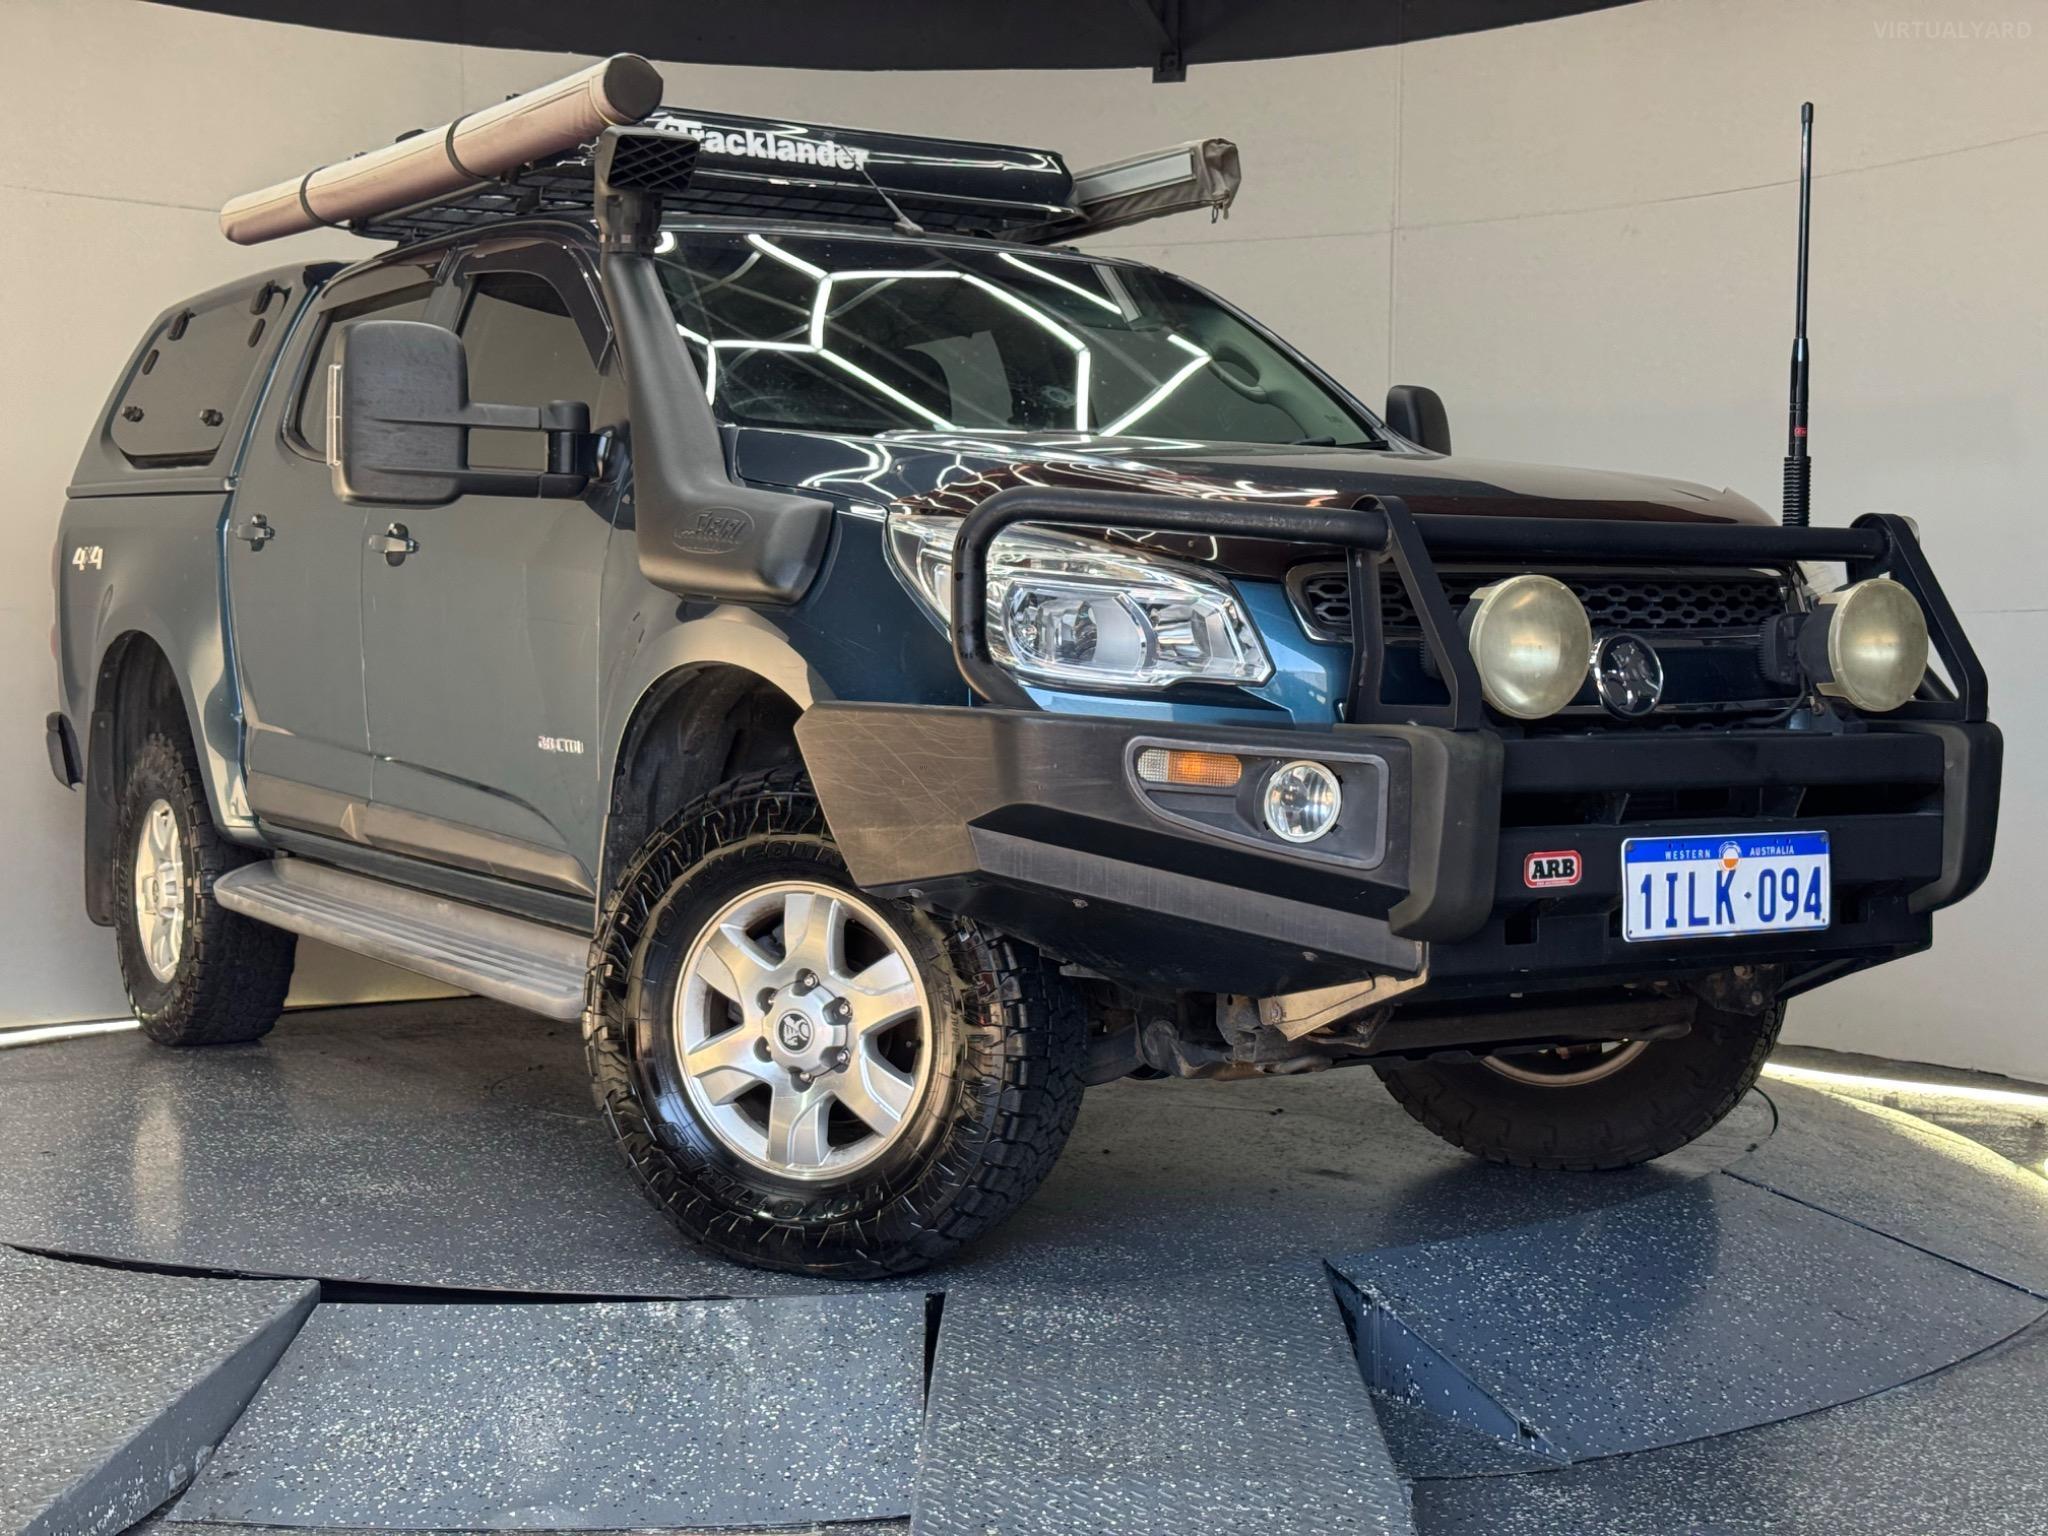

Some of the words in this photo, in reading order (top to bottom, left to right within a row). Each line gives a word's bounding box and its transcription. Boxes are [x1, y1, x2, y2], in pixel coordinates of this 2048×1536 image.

[1665, 849, 1711, 860] WESTERN
[1749, 845, 1794, 856] AUSTRALIA
[1531, 858, 1575, 880] ARB
